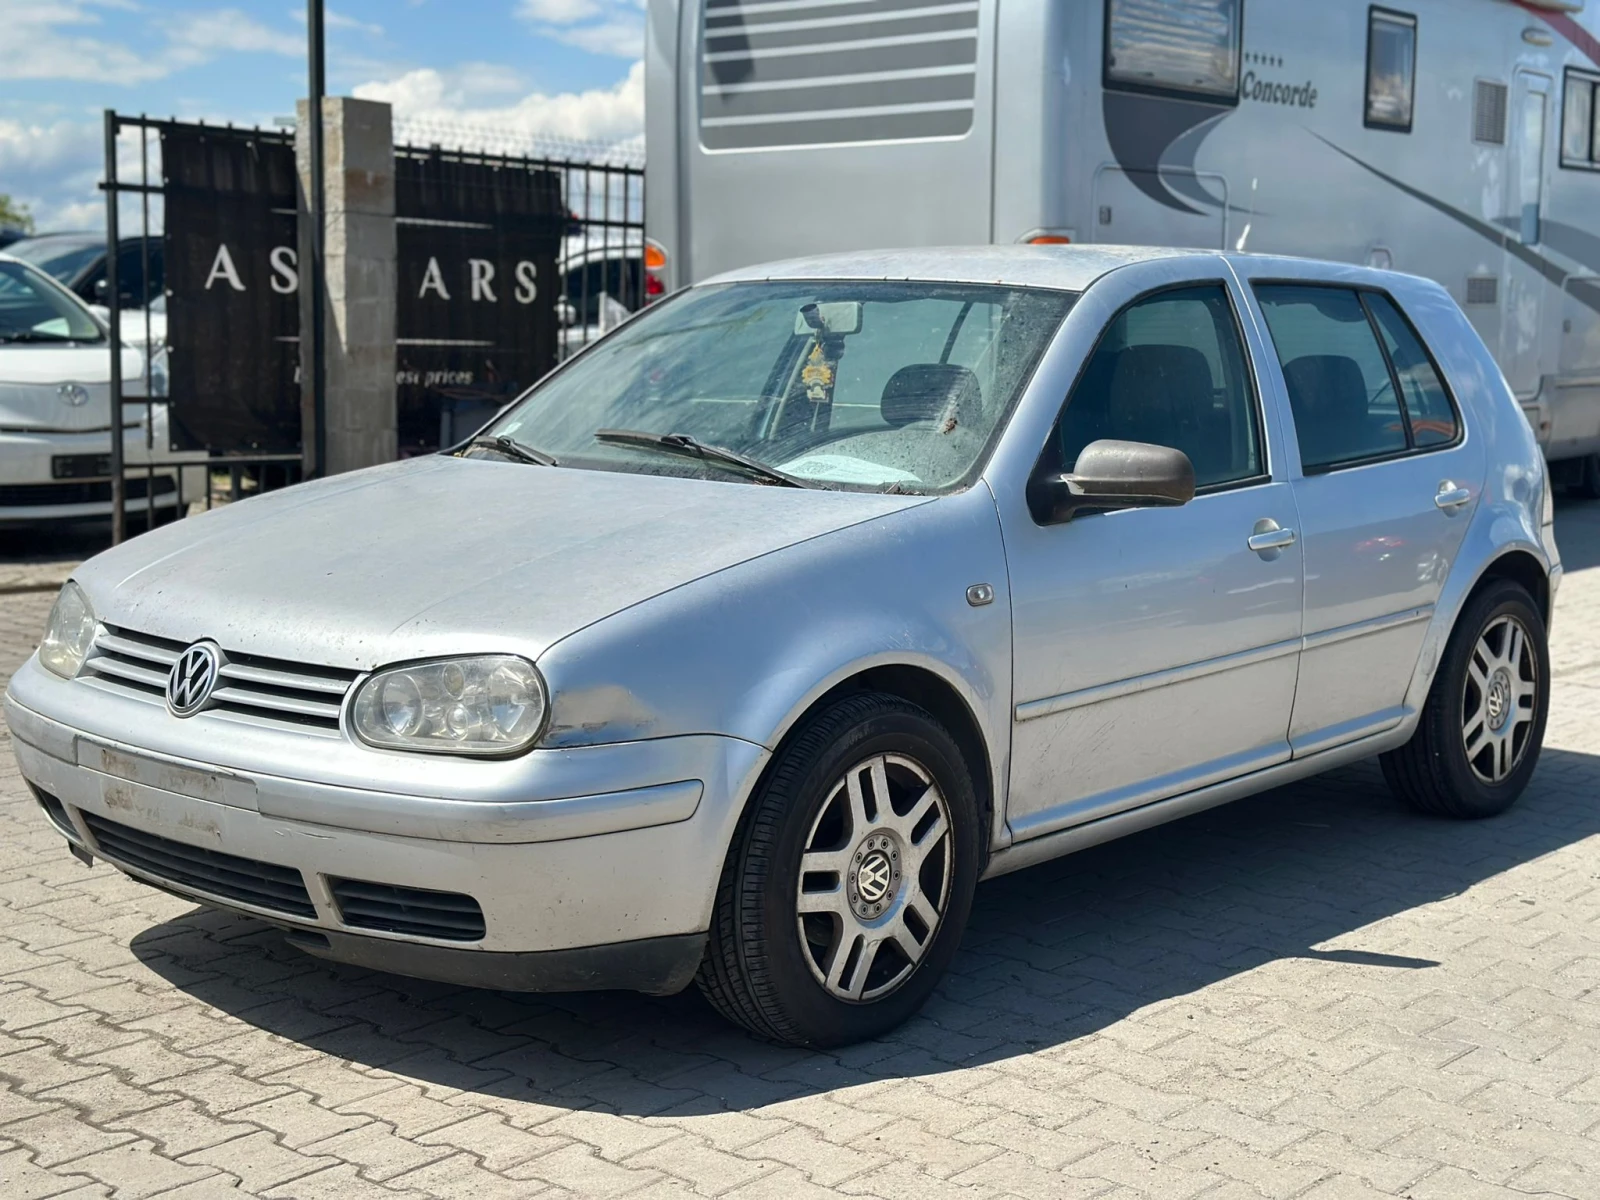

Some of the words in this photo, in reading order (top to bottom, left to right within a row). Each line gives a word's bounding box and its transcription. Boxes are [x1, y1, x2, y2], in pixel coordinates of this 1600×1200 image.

[1242, 70, 1318, 108] Concorde
[419, 256, 537, 304] ARS
[424, 369, 474, 388] prices
